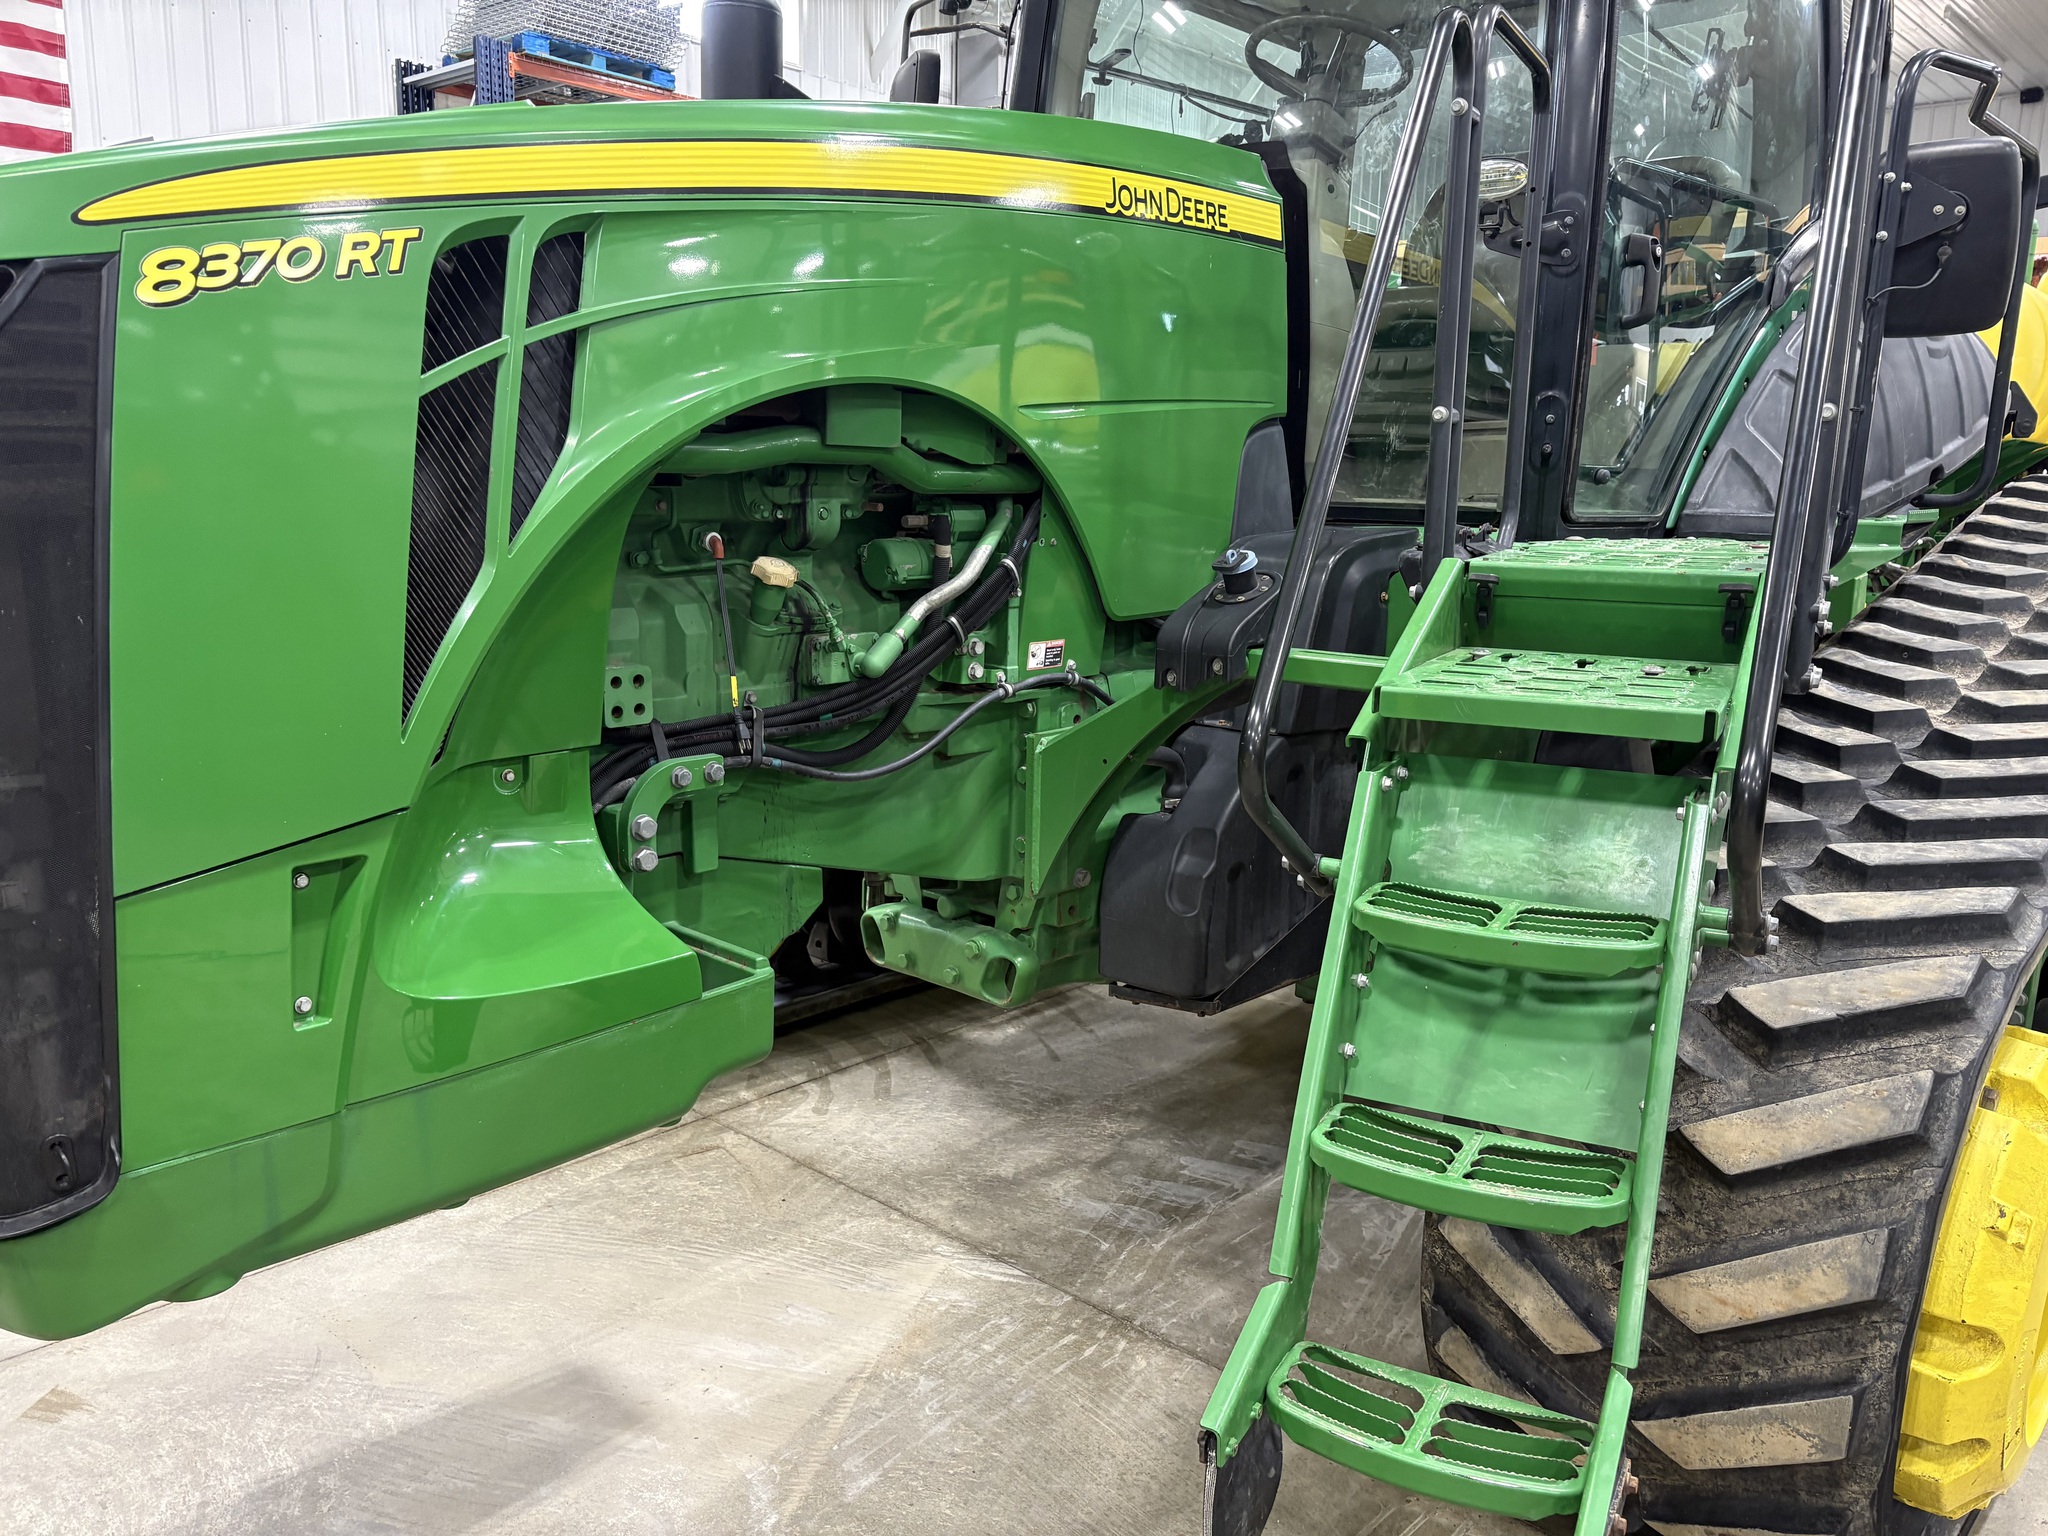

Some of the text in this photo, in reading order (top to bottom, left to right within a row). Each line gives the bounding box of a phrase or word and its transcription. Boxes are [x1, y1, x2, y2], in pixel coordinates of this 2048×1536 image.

[1105, 176, 1229, 229] JOHN DEERE
[135, 227, 424, 308] 8370 RT
